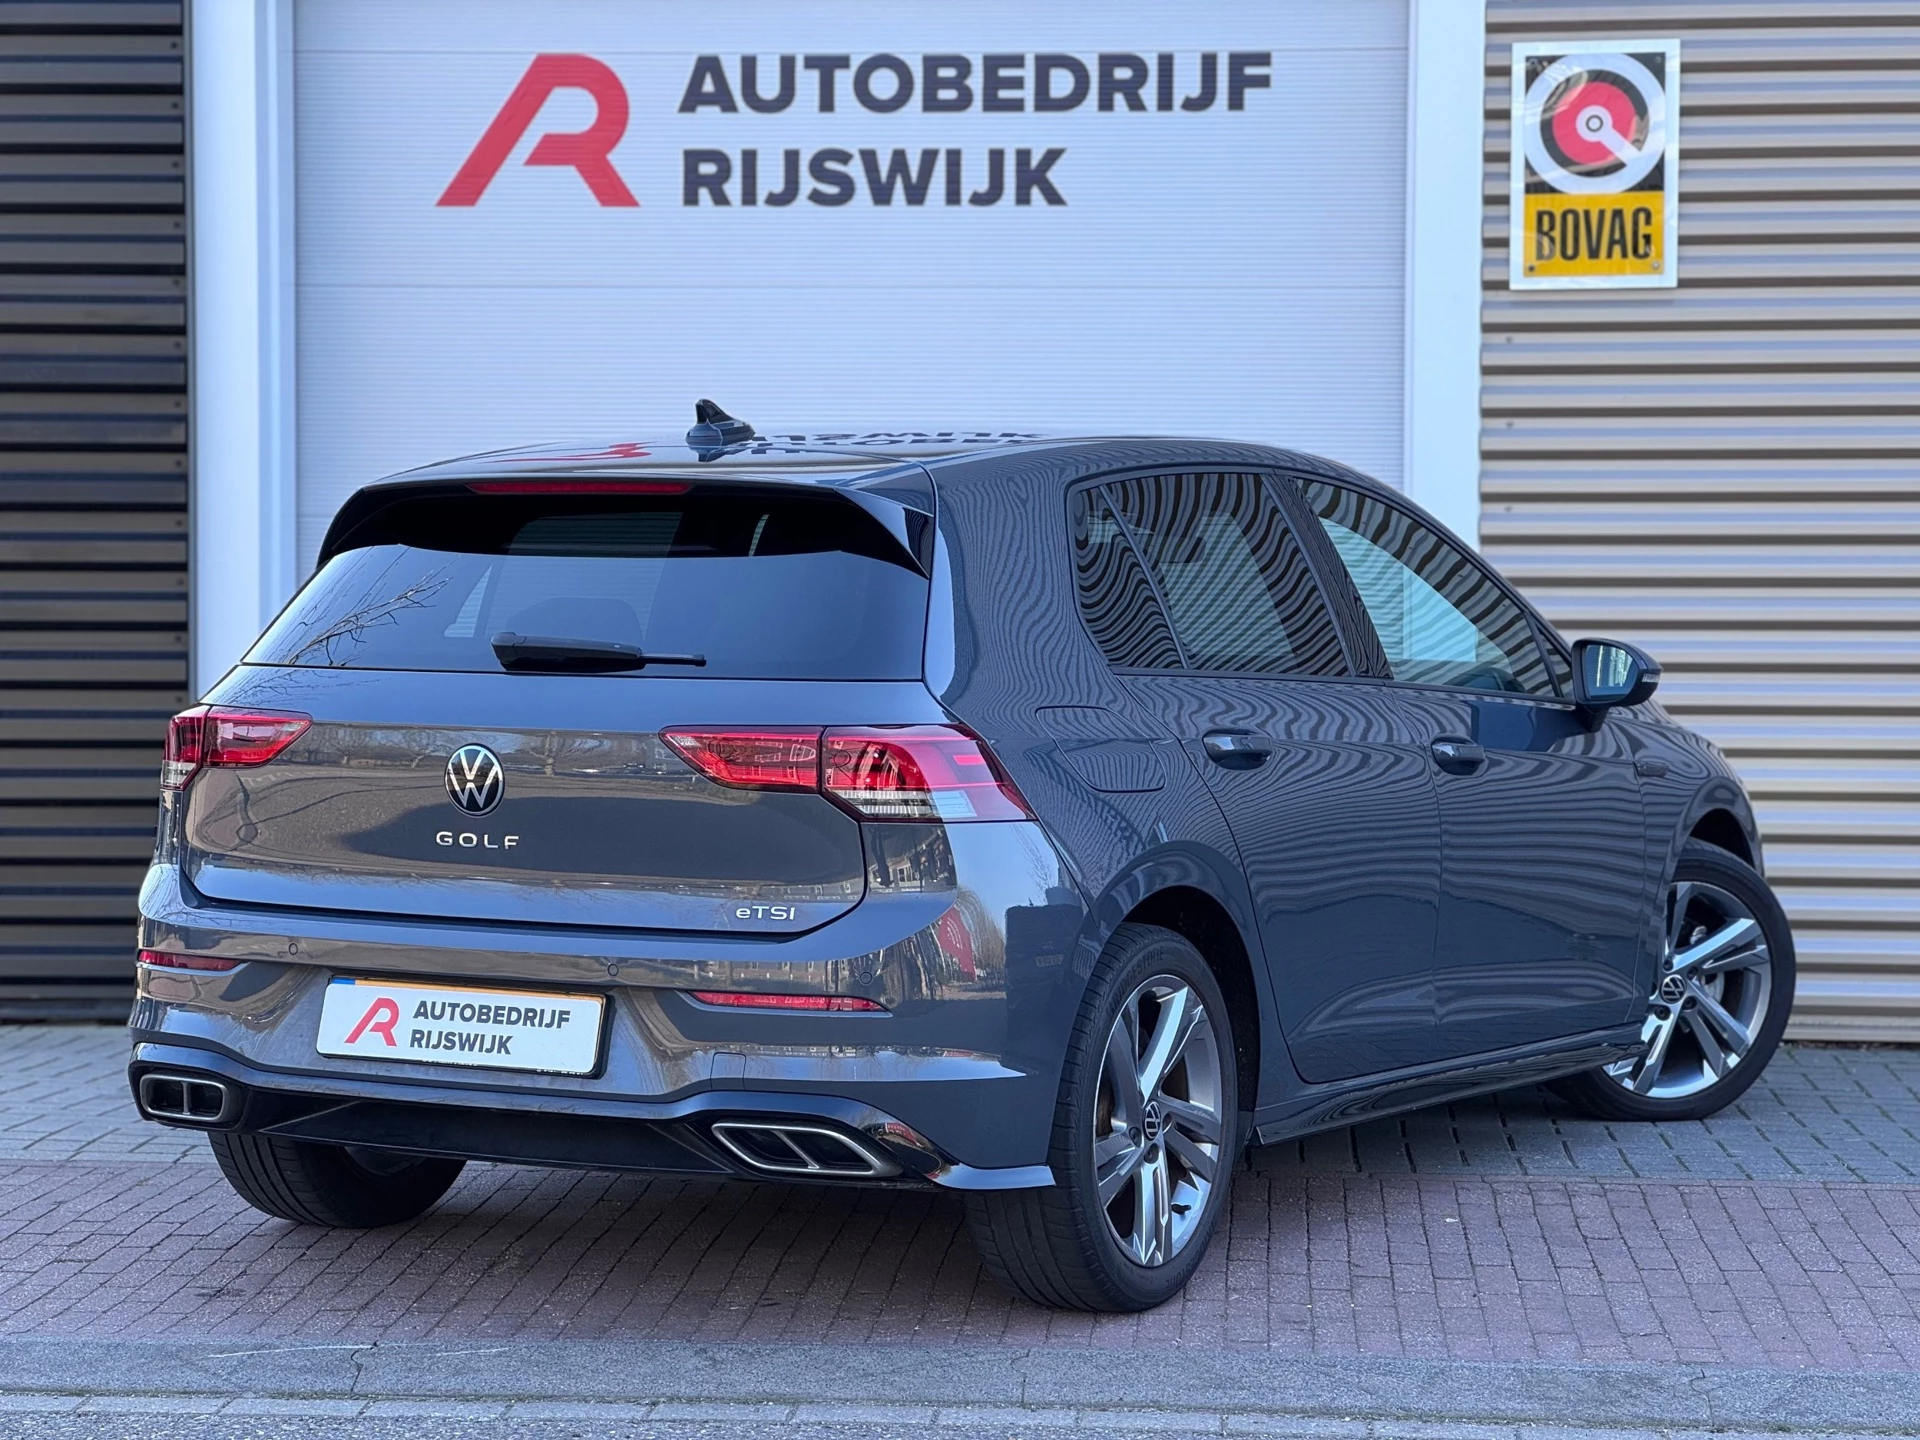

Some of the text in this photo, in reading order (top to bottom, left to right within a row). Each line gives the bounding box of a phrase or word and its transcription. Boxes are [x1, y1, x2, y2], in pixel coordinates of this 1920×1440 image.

[679, 51, 1273, 114] AUTOBEDRIJF
[681, 147, 1068, 208] RIJSWIJK
[1536, 207, 1652, 261] BOVAG
[435, 830, 520, 851] GOLF
[735, 904, 796, 921] eTSI
[412, 1000, 571, 1029] AUTOBEDRIJF
[409, 1029, 514, 1056] RIJSWIJK
